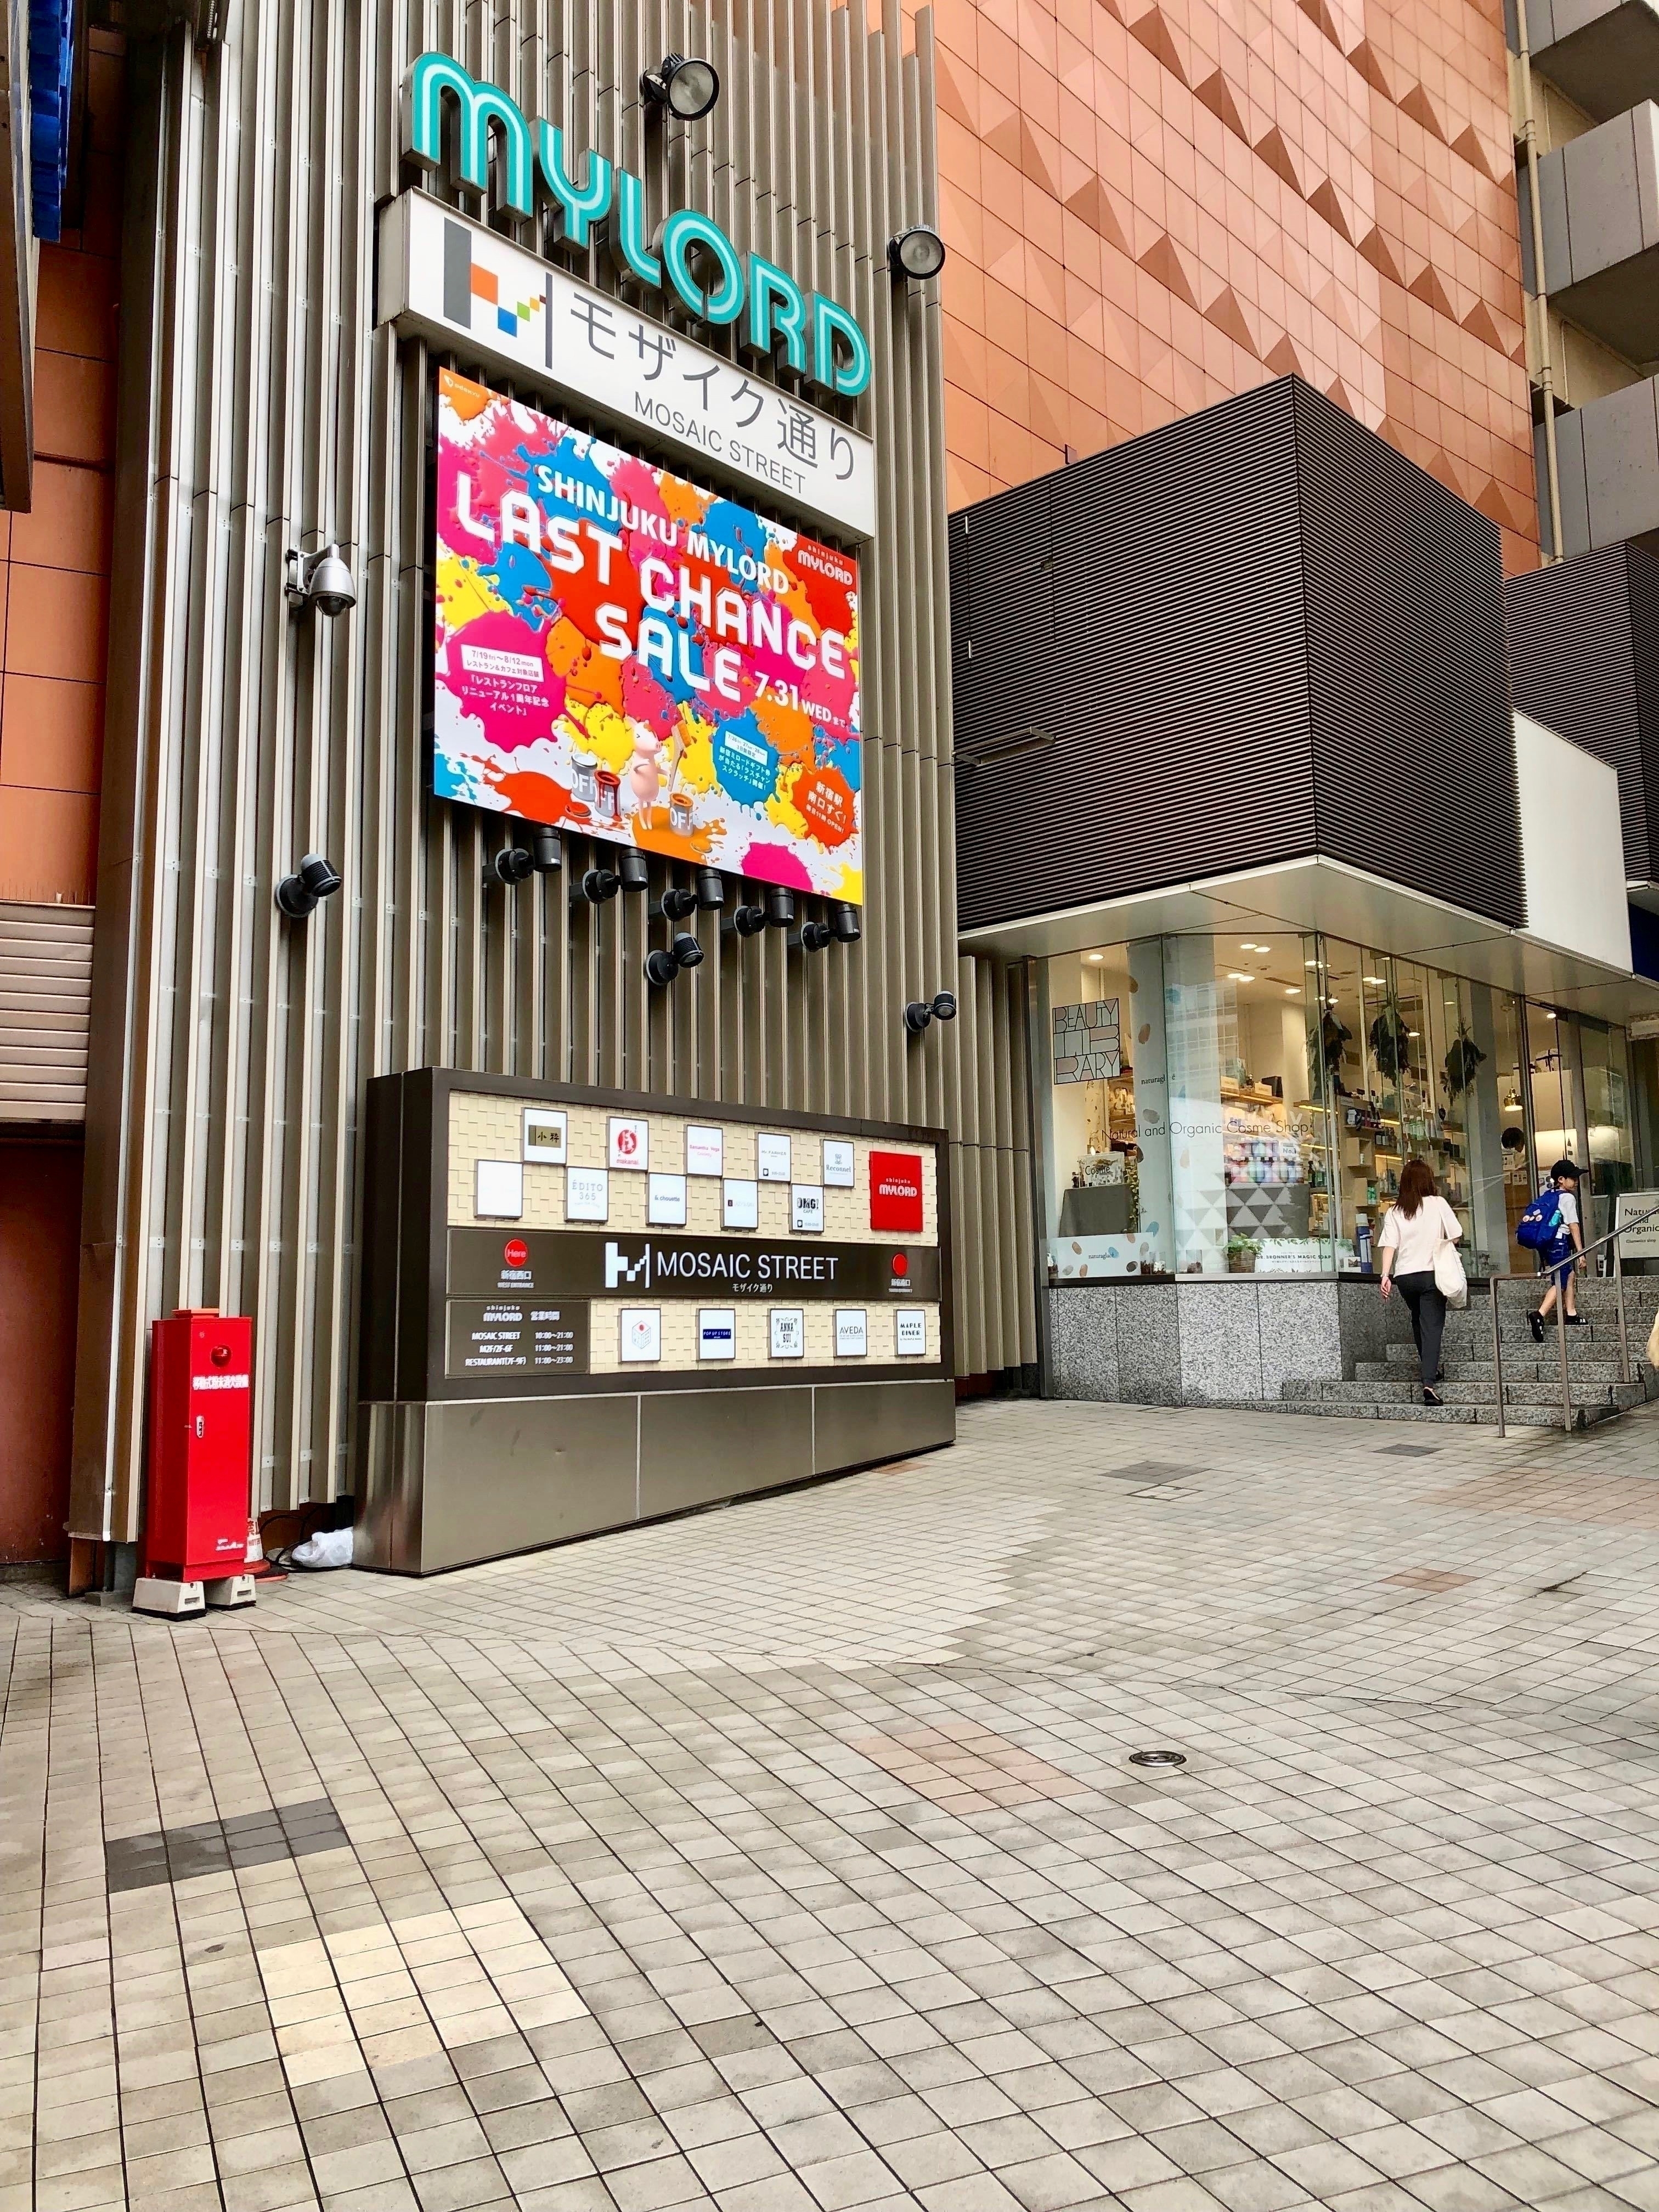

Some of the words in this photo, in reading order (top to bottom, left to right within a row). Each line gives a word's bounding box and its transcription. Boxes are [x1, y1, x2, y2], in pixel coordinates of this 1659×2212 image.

[411, 51, 871, 397] MYLORD
[571, 292, 854, 480] モザイク通り
[635, 391, 723, 453] MOSAIC
[730, 439, 806, 494] STREET
[456, 473, 623, 585] LAST
[538, 464, 678, 548] SHINJUKU
[687, 533, 789, 595] MYLORD
[798, 550, 853, 585] MYLORD
[640, 556, 845, 680] CHANCE
[596, 603, 741, 702] SALE
[755, 671, 798, 711] 7.31
[801, 698, 832, 722] WED
[816, 781, 843, 808] 新宿駅
[1054, 998, 1119, 1034] BEAUTY
[1102, 1125, 1141, 1141] Natural
[1145, 1122, 1165, 1136] and
[1170, 1122, 1222, 1138] Organic
[1227, 1121, 1271, 1133] Cosme
[1277, 1120, 1308, 1136] Shop
[572, 1180, 603, 1191] ÉDITO
[579, 1192, 596, 1200] 365
[879, 1184, 917, 1197] MYLORD
[797, 1197, 819, 1210] OMG!
[507, 1249, 526, 1257] Here
[657, 1251, 751, 1279] MOSAIC
[758, 1255, 839, 1280] STREET
[732, 1283, 774, 1293] モザイク通り
[483, 1312, 522, 1322] MYLORD
[780, 1323, 794, 1332] ANNA
[839, 1326, 864, 1334] AVEDA
[783, 1334, 791, 1343] SUI
